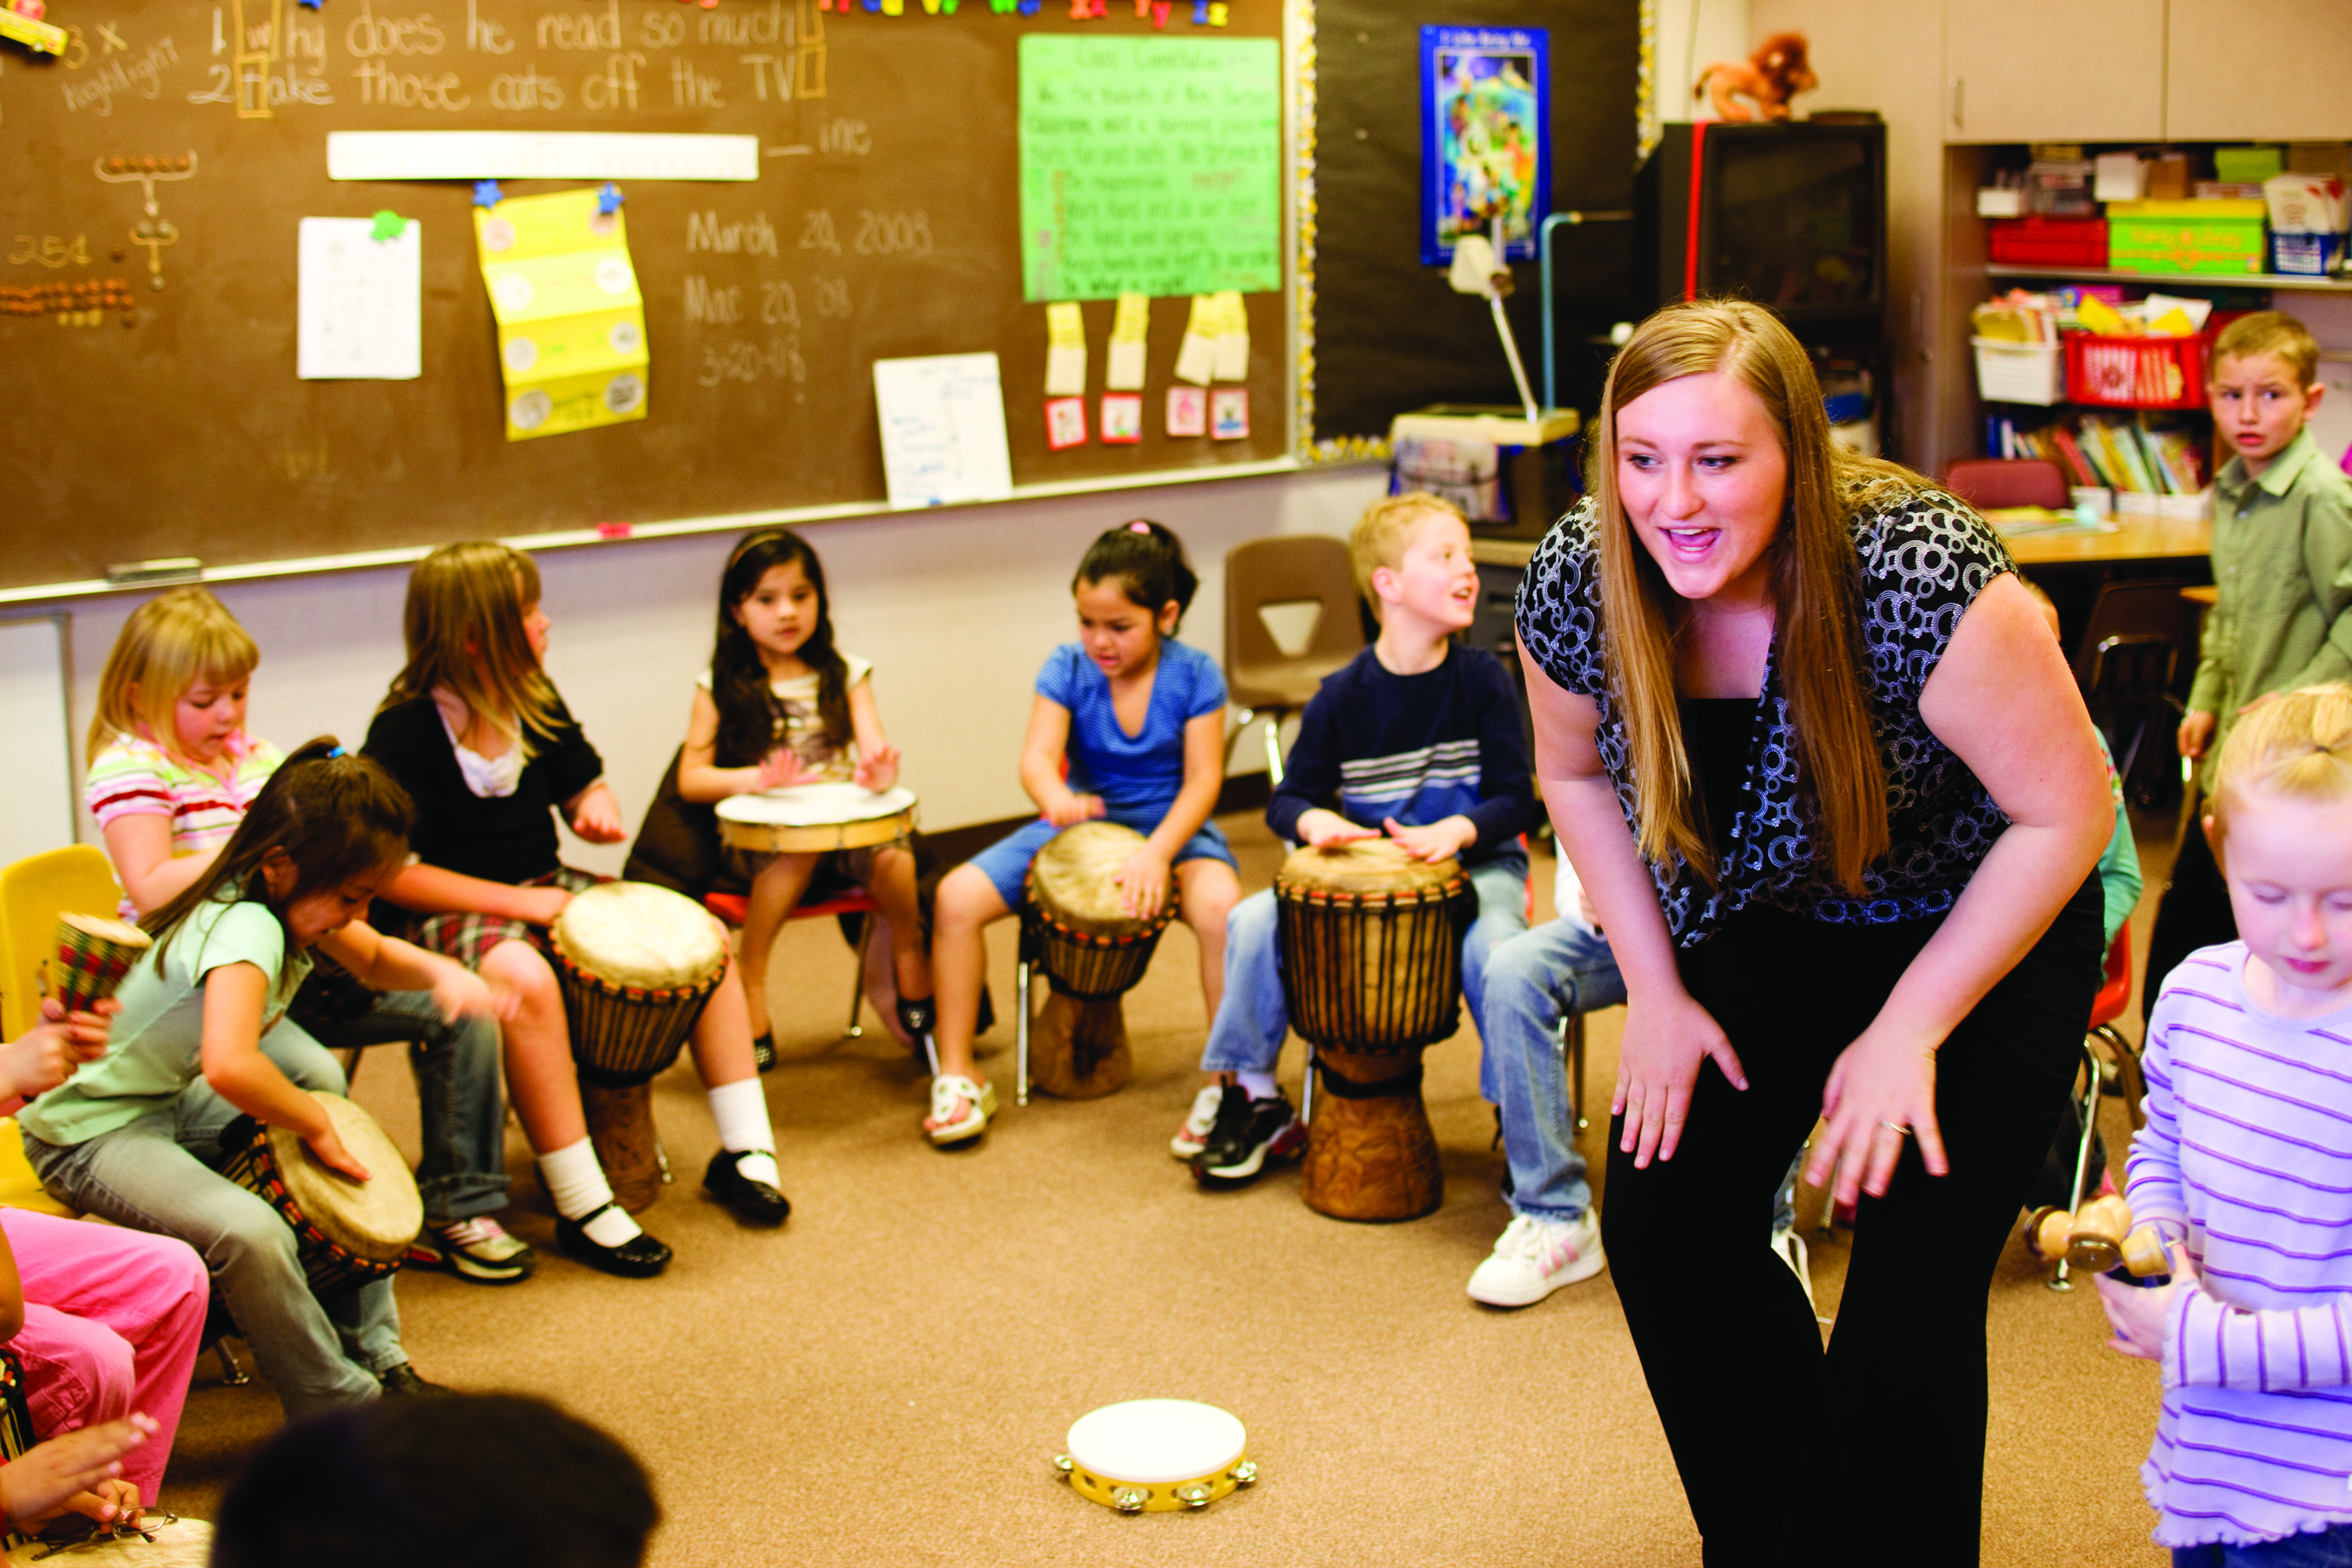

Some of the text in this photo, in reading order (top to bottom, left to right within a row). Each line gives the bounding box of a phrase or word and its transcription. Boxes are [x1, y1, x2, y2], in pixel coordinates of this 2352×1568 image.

[344, 0, 446, 57] does
[466, 0, 515, 54] he
[536, 0, 622, 51] read
[640, 9, 686, 49] so
[699, 0, 795, 49] much
[350, 57, 471, 112] those
[489, 62, 566, 112] cats
[580, 50, 647, 111] off
[670, 55, 727, 109] the
[739, 52, 796, 103] TV
[853, 208, 933, 255] 2008
